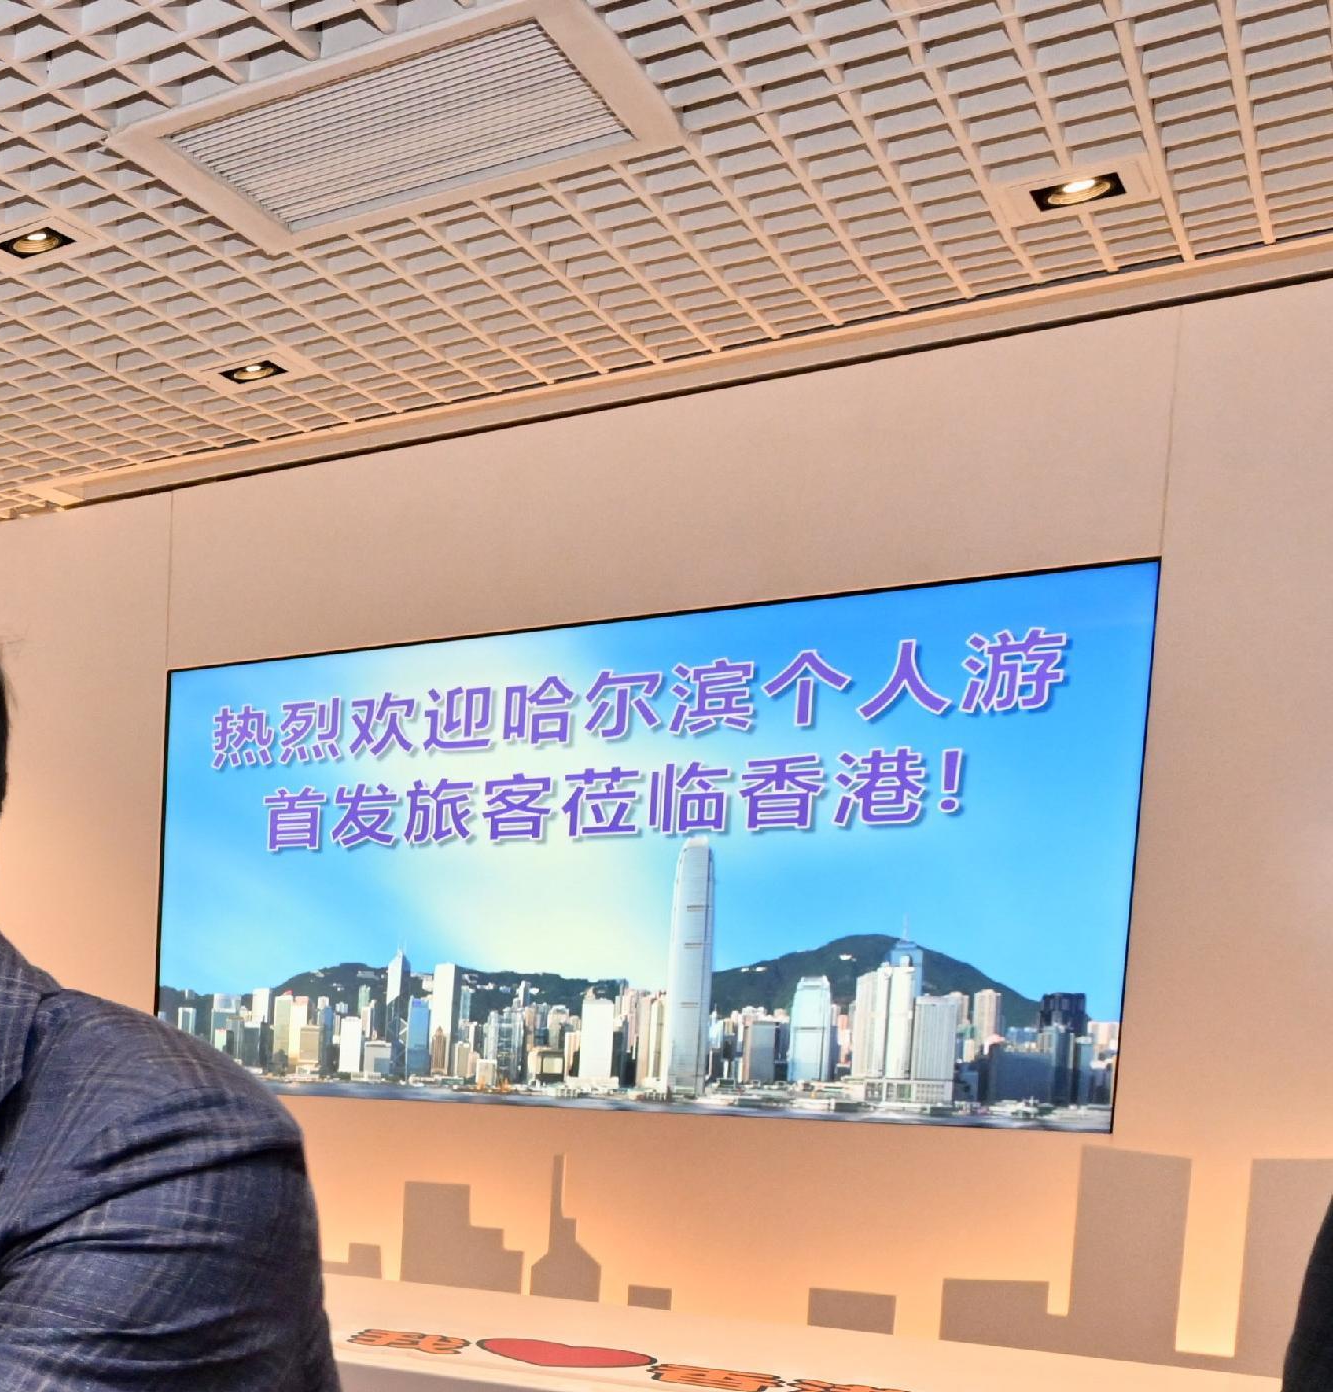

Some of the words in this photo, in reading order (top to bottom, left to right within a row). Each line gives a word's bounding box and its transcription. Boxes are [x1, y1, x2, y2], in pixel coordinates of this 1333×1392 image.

[211, 628, 1066, 769] 热烈欢迎哈尔滨个人游
